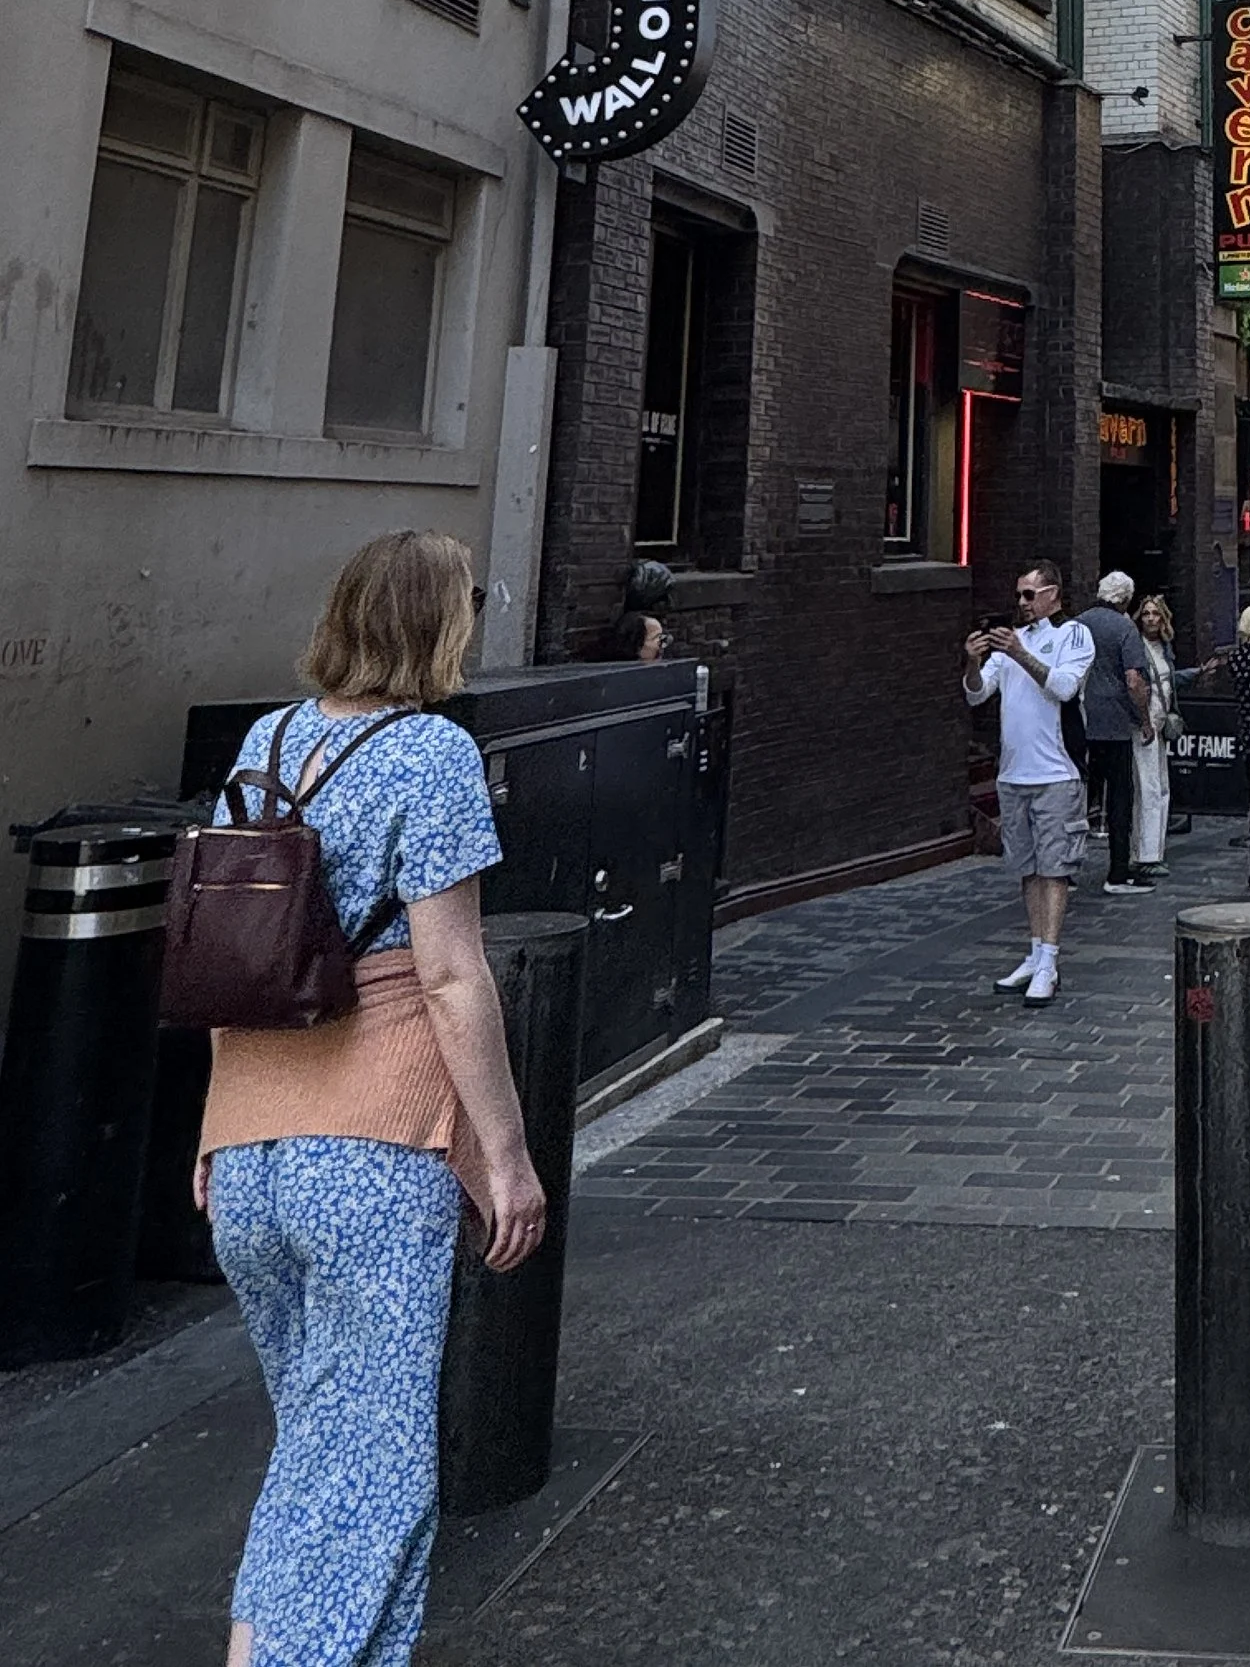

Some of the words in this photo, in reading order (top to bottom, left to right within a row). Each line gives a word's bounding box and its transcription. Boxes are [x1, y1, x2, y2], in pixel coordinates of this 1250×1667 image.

[559, 50, 666, 126] WALL
[1177, 735, 1197, 756] OF
[1198, 737, 1236, 759] FAME
